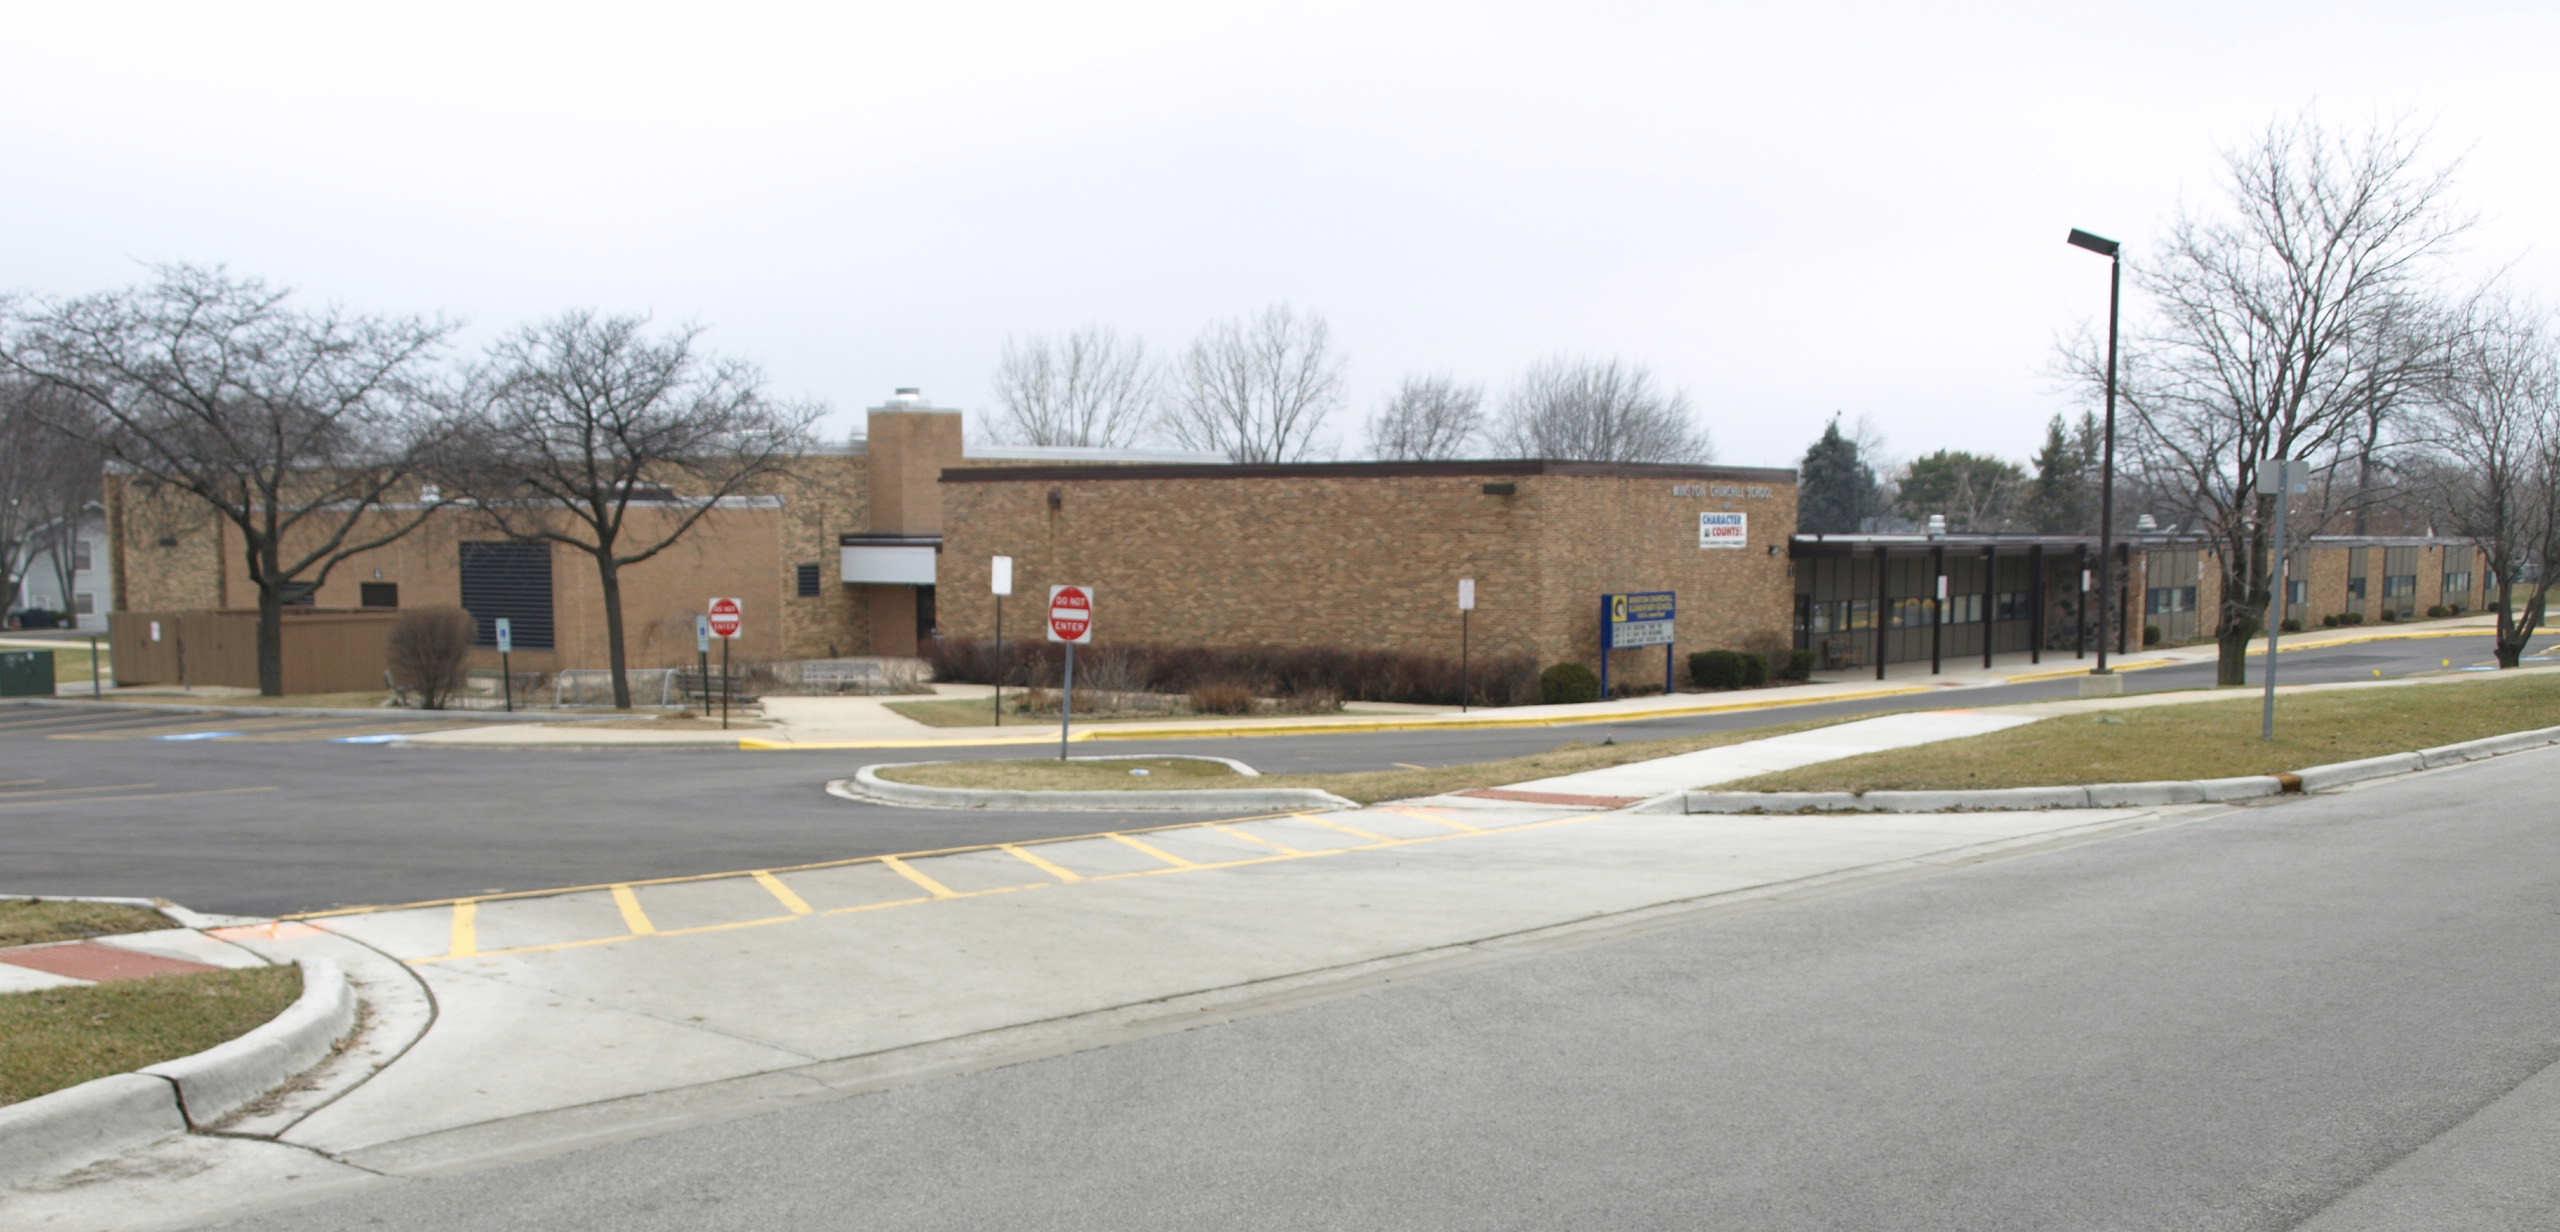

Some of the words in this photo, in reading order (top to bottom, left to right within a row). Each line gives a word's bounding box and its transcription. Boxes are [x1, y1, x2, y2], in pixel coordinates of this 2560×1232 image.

[1702, 515, 1742, 526] CHARACTER
[1056, 596, 1068, 606] DO
[1070, 596, 1085, 607] NOT
[1055, 621, 1085, 632] ENTER
